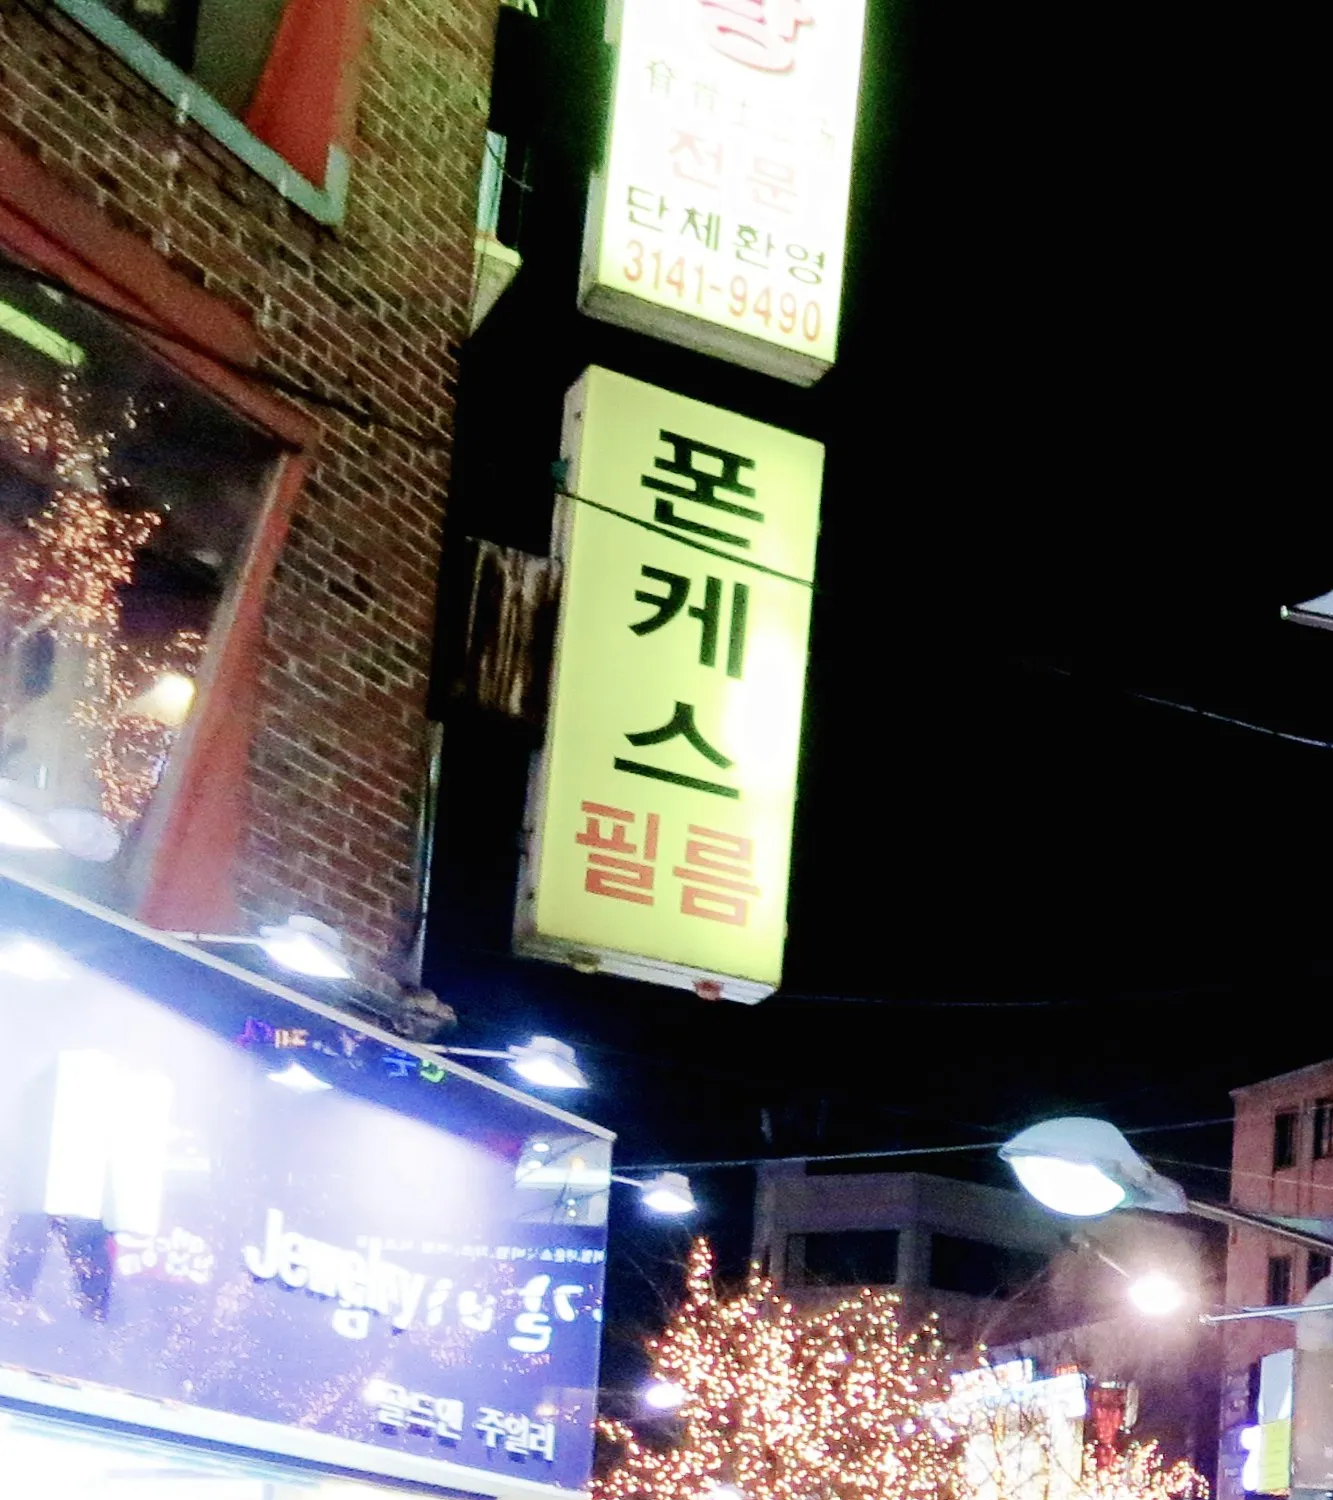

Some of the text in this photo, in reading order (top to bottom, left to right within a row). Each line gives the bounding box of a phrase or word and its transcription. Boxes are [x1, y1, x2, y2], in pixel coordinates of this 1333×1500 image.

[627, 185, 827, 285] 단체환영
[623, 239, 823, 343] 3141-9490
[574, 800, 763, 927] 필름
[244, 1208, 430, 1329] Jewelry
[473, 1405, 555, 1462] 주얼리
